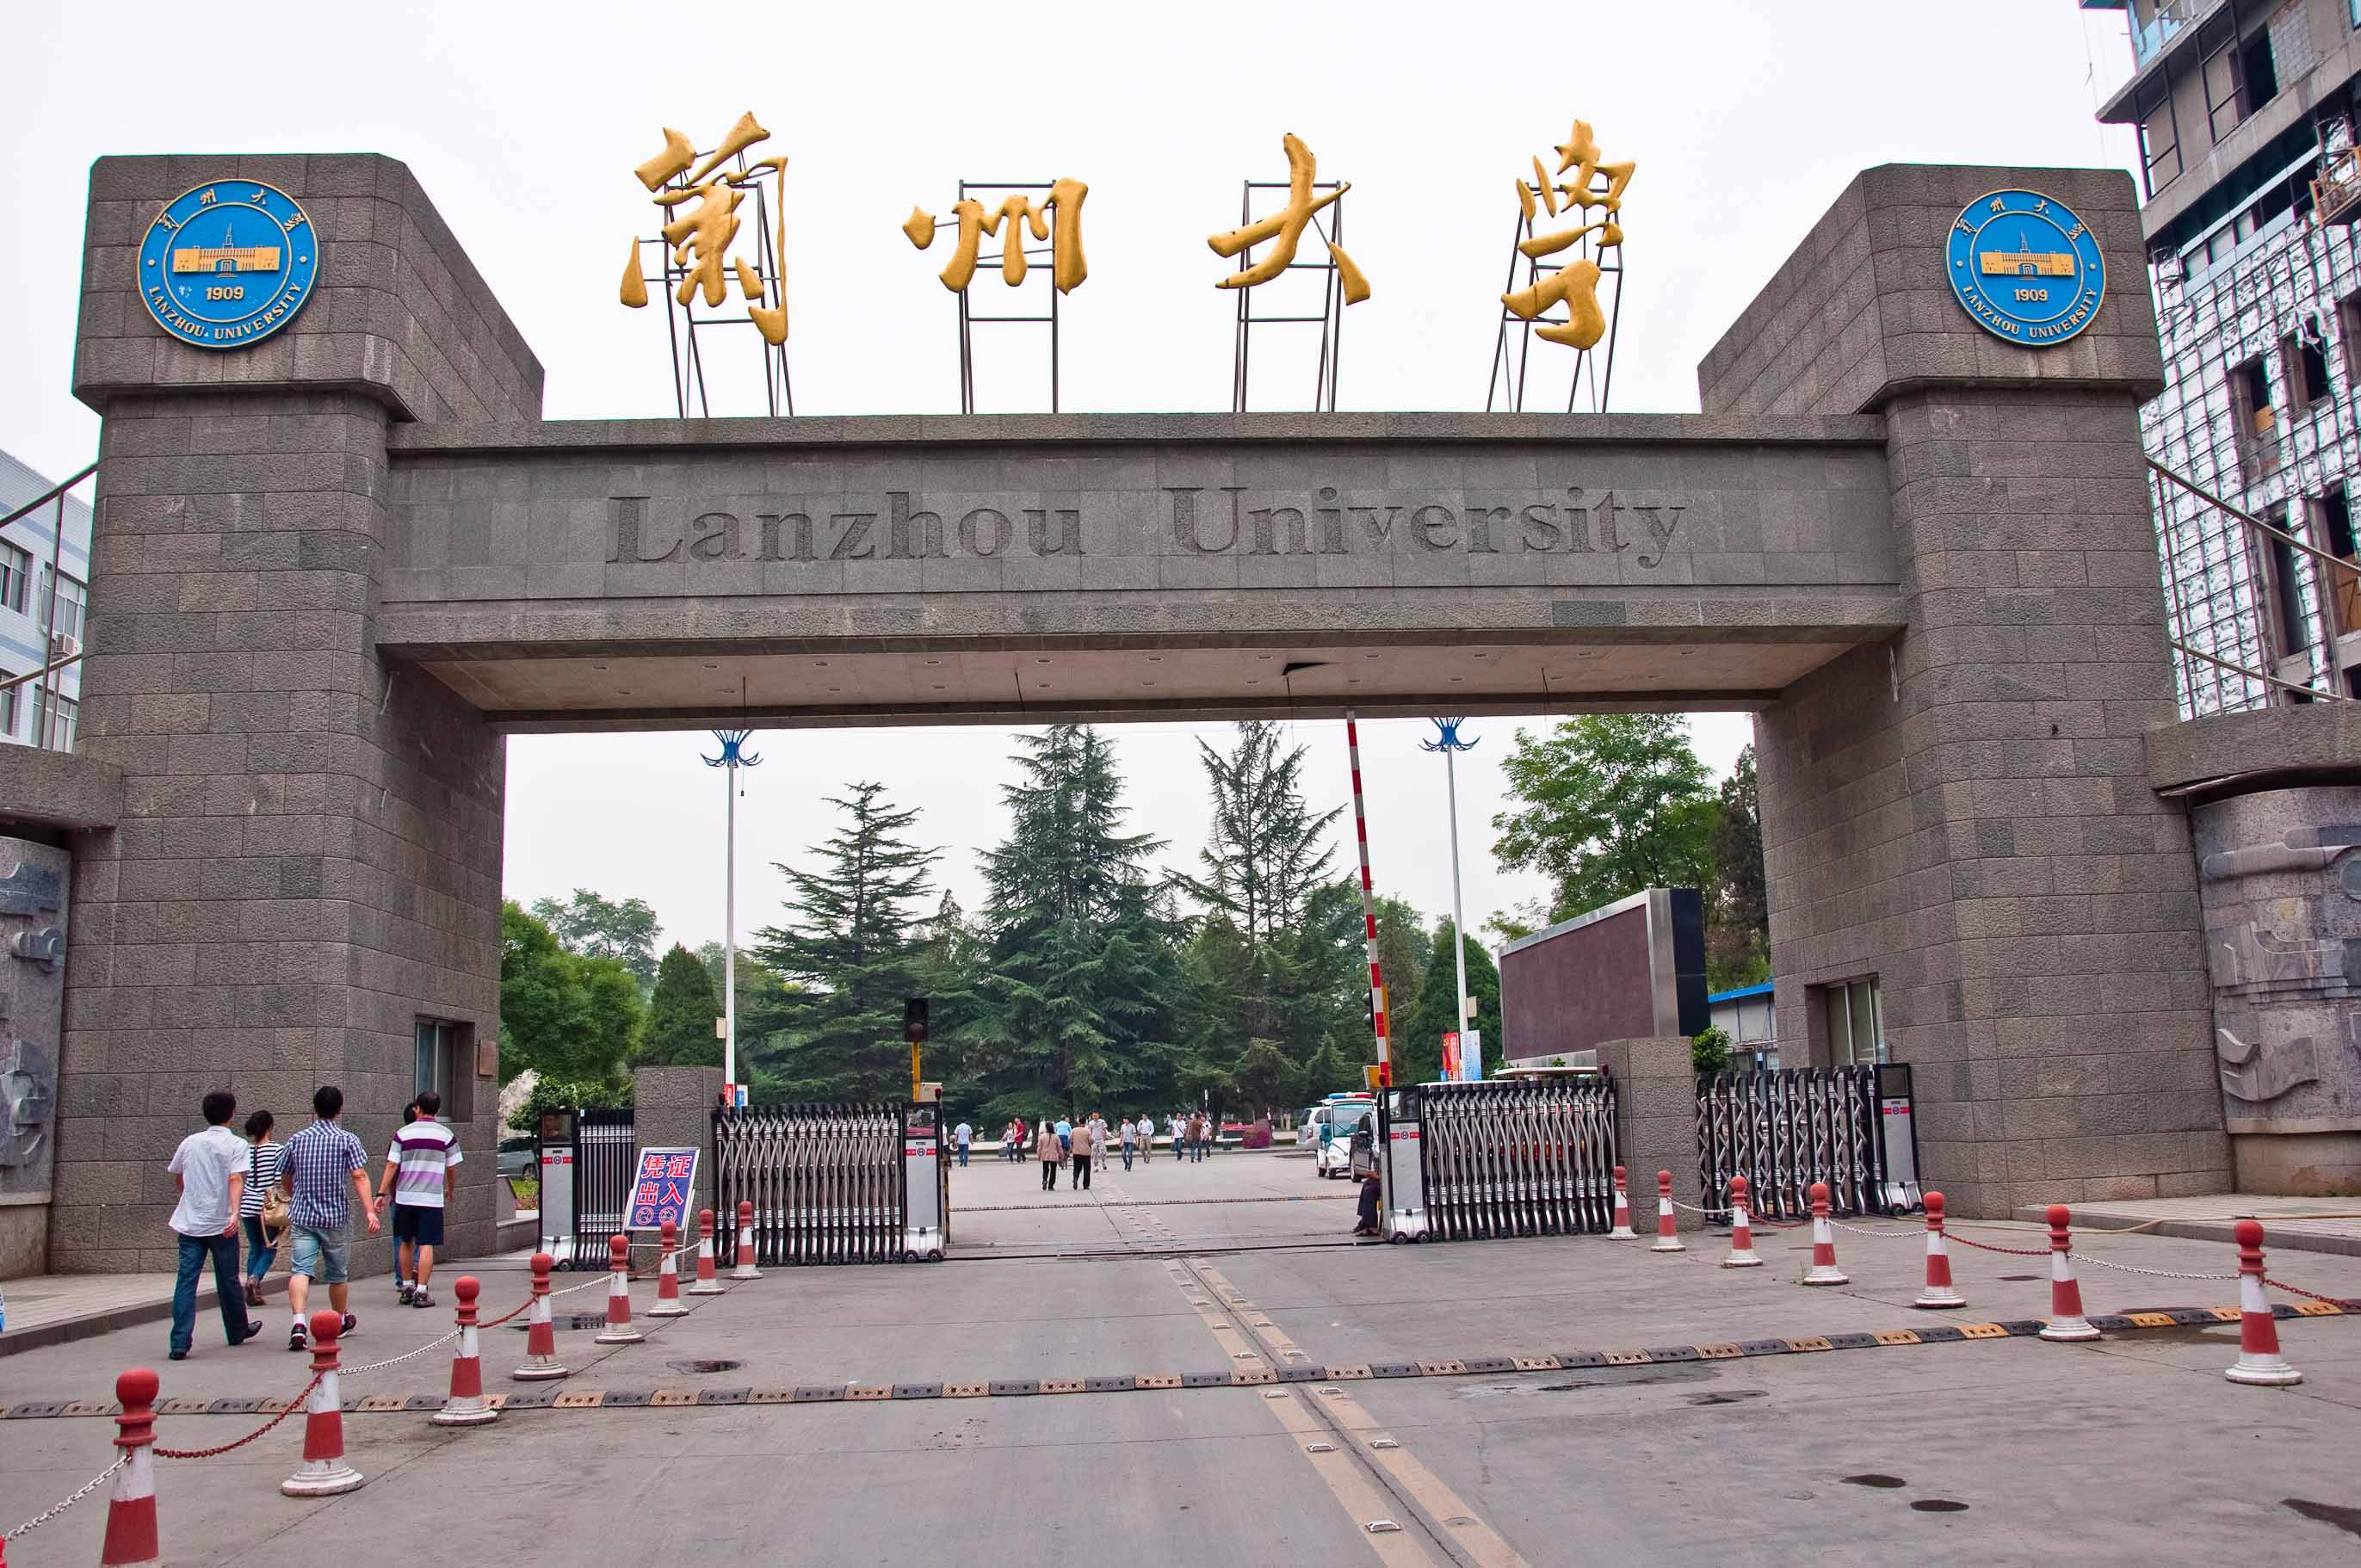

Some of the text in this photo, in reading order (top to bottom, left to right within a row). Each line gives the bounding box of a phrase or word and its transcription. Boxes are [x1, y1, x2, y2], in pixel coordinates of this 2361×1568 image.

[206, 286, 244, 301] 1909
[2014, 288, 2049, 302] 1909
[148, 281, 301, 340] LANZHOU UNIVERSITY
[1962, 285, 2097, 338] LANZHOU UNIVERSITY
[605, 486, 1686, 570] Lanzhou University
[640, 1154, 692, 1179] 凭证
[635, 1181, 685, 1206] 出入
